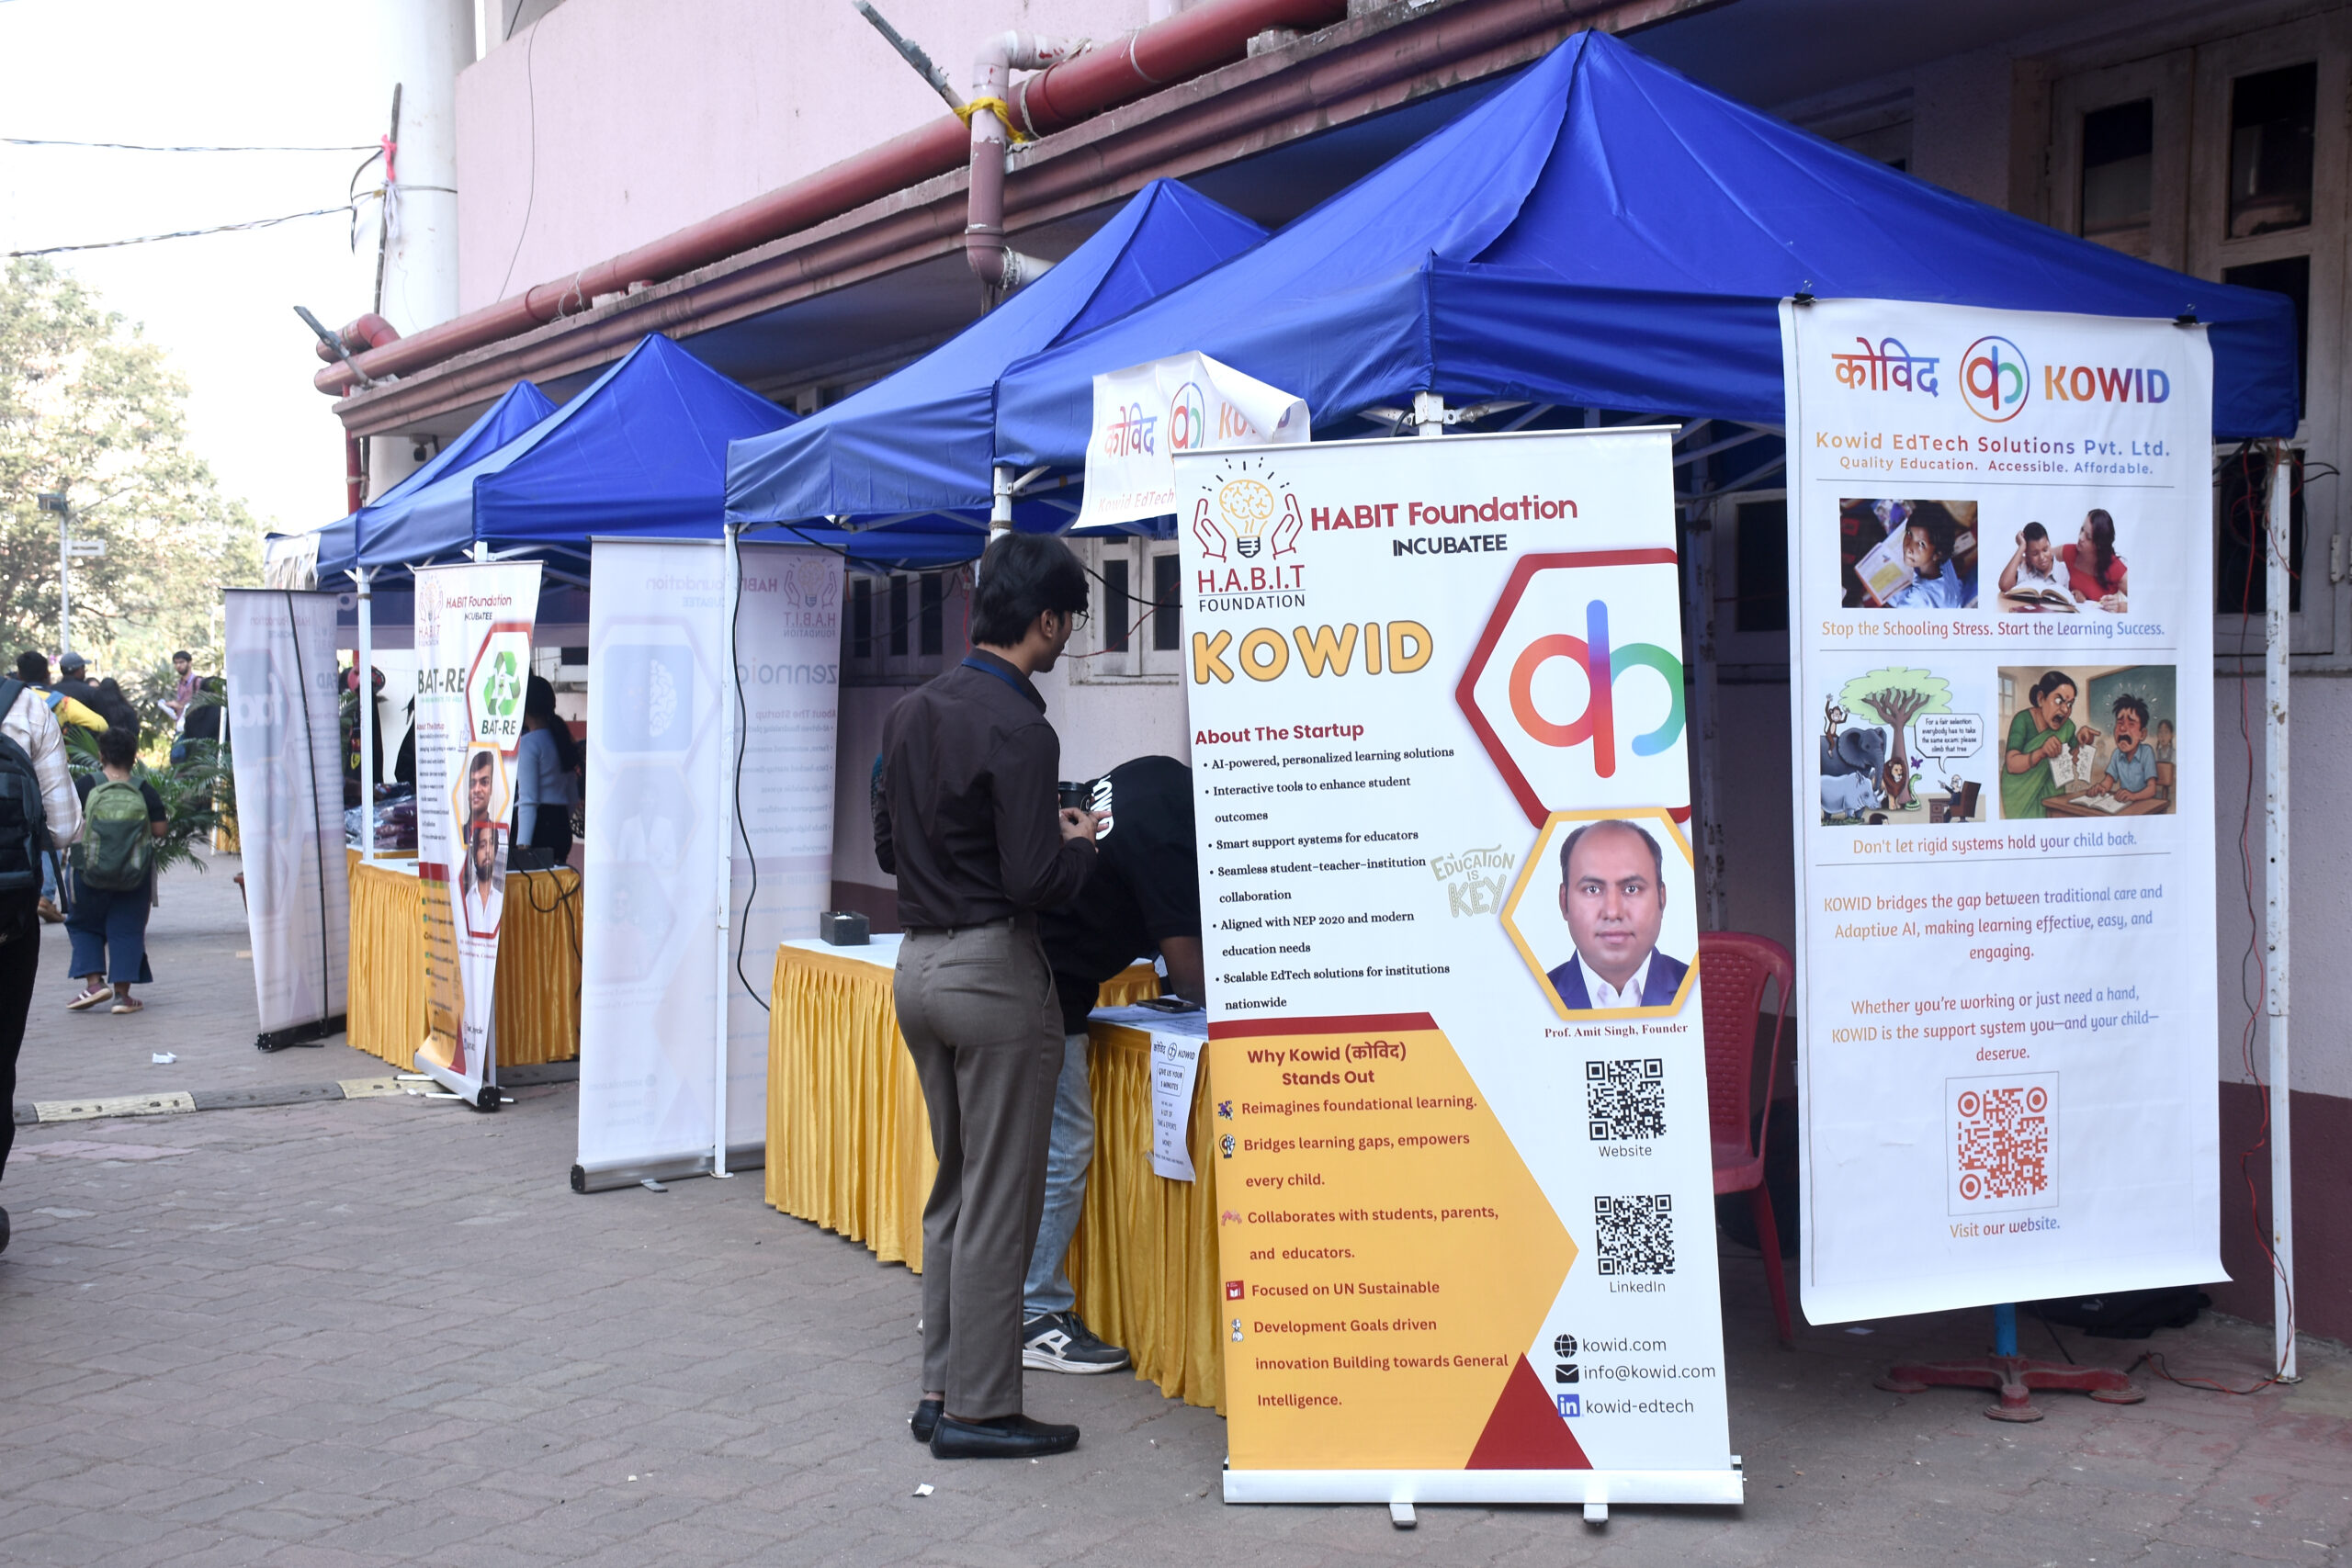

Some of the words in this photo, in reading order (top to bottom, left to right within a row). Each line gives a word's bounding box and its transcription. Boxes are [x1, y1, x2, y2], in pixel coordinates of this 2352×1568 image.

[1831, 336, 1939, 397] कोविद
[2044, 366, 2170, 404] KOWID
[1104, 402, 1158, 457] कोविद
[1816, 431, 1882, 449] Kowid
[1893, 434, 1968, 452] EdTech
[1977, 435, 2075, 455] Solutions
[2084, 439, 2122, 456] Pvt.
[2132, 440, 2169, 456] Ltd.
[1839, 456, 1894, 471] Quality
[1900, 457, 1977, 470] Education.
[1987, 459, 2068, 472] Accessible.
[2074, 461, 2153, 474] Affordable.
[1134, 488, 1174, 508] EdTech
[1311, 503, 1398, 531] HABIT
[1408, 496, 1577, 526] Foundation
[1393, 535, 1508, 557] INCUBATEE
[1197, 564, 1305, 593] H.A.B.I.T
[447, 596, 467, 608] HABIT
[469, 593, 512, 607] Foundation
[1199, 593, 1305, 612] FOUNDATION
[1822, 621, 1853, 639] Stop
[1858, 620, 1879, 635] the
[1883, 620, 1948, 639] Schooling
[1952, 621, 1993, 636] Stress.
[1997, 621, 2030, 635] Start
[2032, 620, 2053, 635] the
[2057, 621, 2113, 638] Learning
[2117, 621, 2164, 635] Success.
[1192, 620, 1433, 685] KOWID
[418, 668, 465, 694] BAT-RE
[481, 720, 516, 735] BAT-RE
[1194, 728, 1250, 745] About
[1254, 726, 1289, 741] The
[1293, 723, 1363, 741] Startup
[1211, 755, 1280, 771] AI-powered,
[1282, 750, 1352, 768] personalized
[1354, 749, 1401, 761] learning
[1403, 747, 1454, 759] solutions
[1213, 783, 1273, 796] Interactive
[1276, 780, 1303, 793] tools
[1306, 782, 1317, 791] to
[1319, 778, 1365, 790] enhance
[1368, 775, 1410, 787] student
[1215, 812, 1268, 823] outcomes
[1216, 839, 1250, 850] Smart
[1251, 837, 1295, 849] support
[1297, 835, 1342, 847] systems
[1345, 831, 1362, 842] for
[1363, 830, 1419, 841] educators
[1853, 839, 1891, 853] Don't
[1895, 838, 1914, 852] let
[1917, 837, 1948, 855] rigid
[1951, 837, 2004, 854] systems
[2007, 833, 2036, 849] hold
[2040, 837, 2070, 852] your
[2073, 832, 2103, 847] child
[2108, 830, 2136, 846] back.
[1217, 863, 1268, 876] Seamless
[1430, 844, 1515, 882] EDUCATION
[1467, 870, 1479, 881] IS
[1219, 889, 1292, 903] collaboration
[1448, 874, 1507, 918] KEY
[1824, 896, 1871, 911] KOWID
[1876, 894, 1928, 912] bridges
[1931, 893, 1952, 908] the
[1956, 896, 1981, 910] gap
[1985, 891, 2040, 906] between
[2043, 886, 2110, 903] traditional
[2114, 888, 2137, 900] care
[2140, 884, 2162, 898] and
[1835, 922, 1898, 941] Adaptive
[1902, 921, 1920, 938] AI,
[1925, 919, 1974, 937] making
[1978, 917, 2032, 934] learning
[2036, 914, 2094, 933] effective,
[2097, 915, 2127, 930] easy,
[2131, 910, 2153, 925] and
[1969, 942, 2034, 963] engaging.
[1225, 996, 1286, 1010] nationwide
[1850, 998, 1910, 1014] Whether
[1960, 993, 2015, 1010] working
[2018, 995, 2032, 1007] or
[2035, 991, 2060, 1009] just
[2064, 987, 2092, 1004] need
[2096, 991, 2103, 1001] a
[2107, 985, 2139, 1000] hand,
[1544, 1027, 1571, 1038] Prof.
[1574, 1026, 1600, 1036] Amit
[1604, 1024, 1638, 1037] Singh,
[1642, 1022, 1686, 1034] Founder
[1177, 1049, 1195, 1060] KOWID
[1247, 1048, 1285, 1066] Why
[1289, 1045, 1340, 1062] Kowid
[1344, 1040, 1406, 1064] (कोविद)
[1282, 1070, 1340, 1086] Stands
[1343, 1069, 1374, 1083] Out
[1241, 1100, 1320, 1116] Reimagines
[1322, 1096, 1413, 1111] foundational
[1416, 1094, 1476, 1110] learning.
[1244, 1137, 1295, 1153] Bridges
[1298, 1135, 1355, 1151] learning
[1358, 1137, 1394, 1151] gaps,
[1397, 1134, 1470, 1149] empowers
[1598, 1145, 1652, 1156] Website
[1245, 1177, 1283, 1189] every
[1287, 1172, 1325, 1186] child.
[1949, 1222, 1979, 1238] Visit
[1983, 1223, 2005, 1235] our
[2008, 1215, 2060, 1233] website.
[1251, 1283, 1308, 1296] Focused
[1312, 1285, 1329, 1295] on
[1333, 1282, 1354, 1295] UN
[1358, 1280, 1440, 1294] Sustainable
[1610, 1280, 1665, 1292] LinkedIn
[1582, 1337, 1666, 1352] kowid.com
[1584, 1364, 1715, 1382] info@kowid.com
[1586, 1398, 1693, 1414] kowid-edtech
